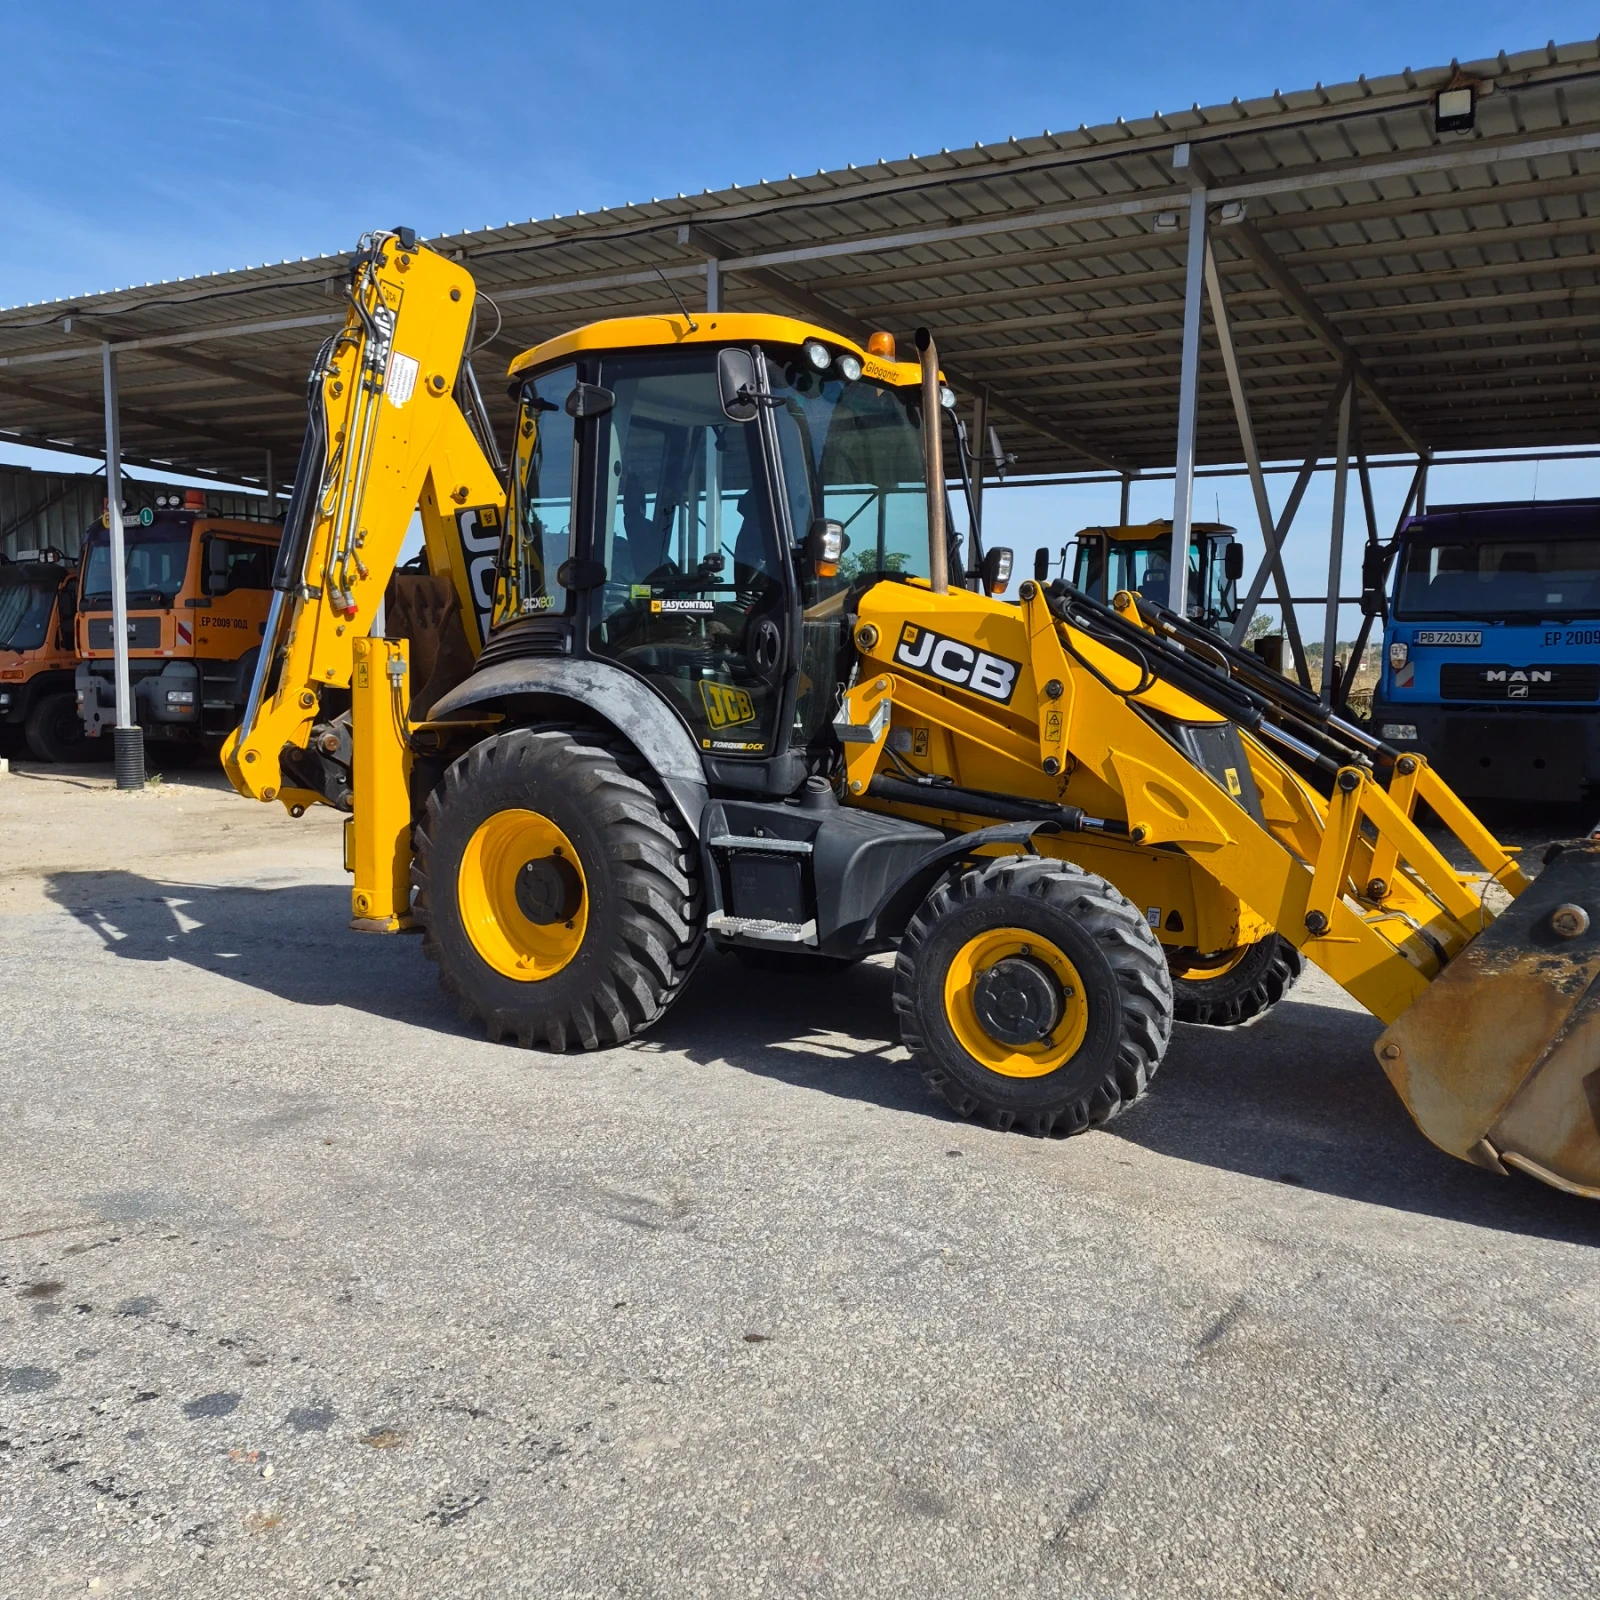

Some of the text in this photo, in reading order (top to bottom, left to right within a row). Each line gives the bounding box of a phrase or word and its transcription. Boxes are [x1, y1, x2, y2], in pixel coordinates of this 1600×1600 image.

[662, 600, 714, 611] EASYCONTROL
[1436, 632, 1463, 643] 7203
[1464, 632, 1480, 643] KX
[898, 632, 1015, 699] JCB
[1486, 670, 1552, 682] MAN
[708, 685, 752, 725] JCB
